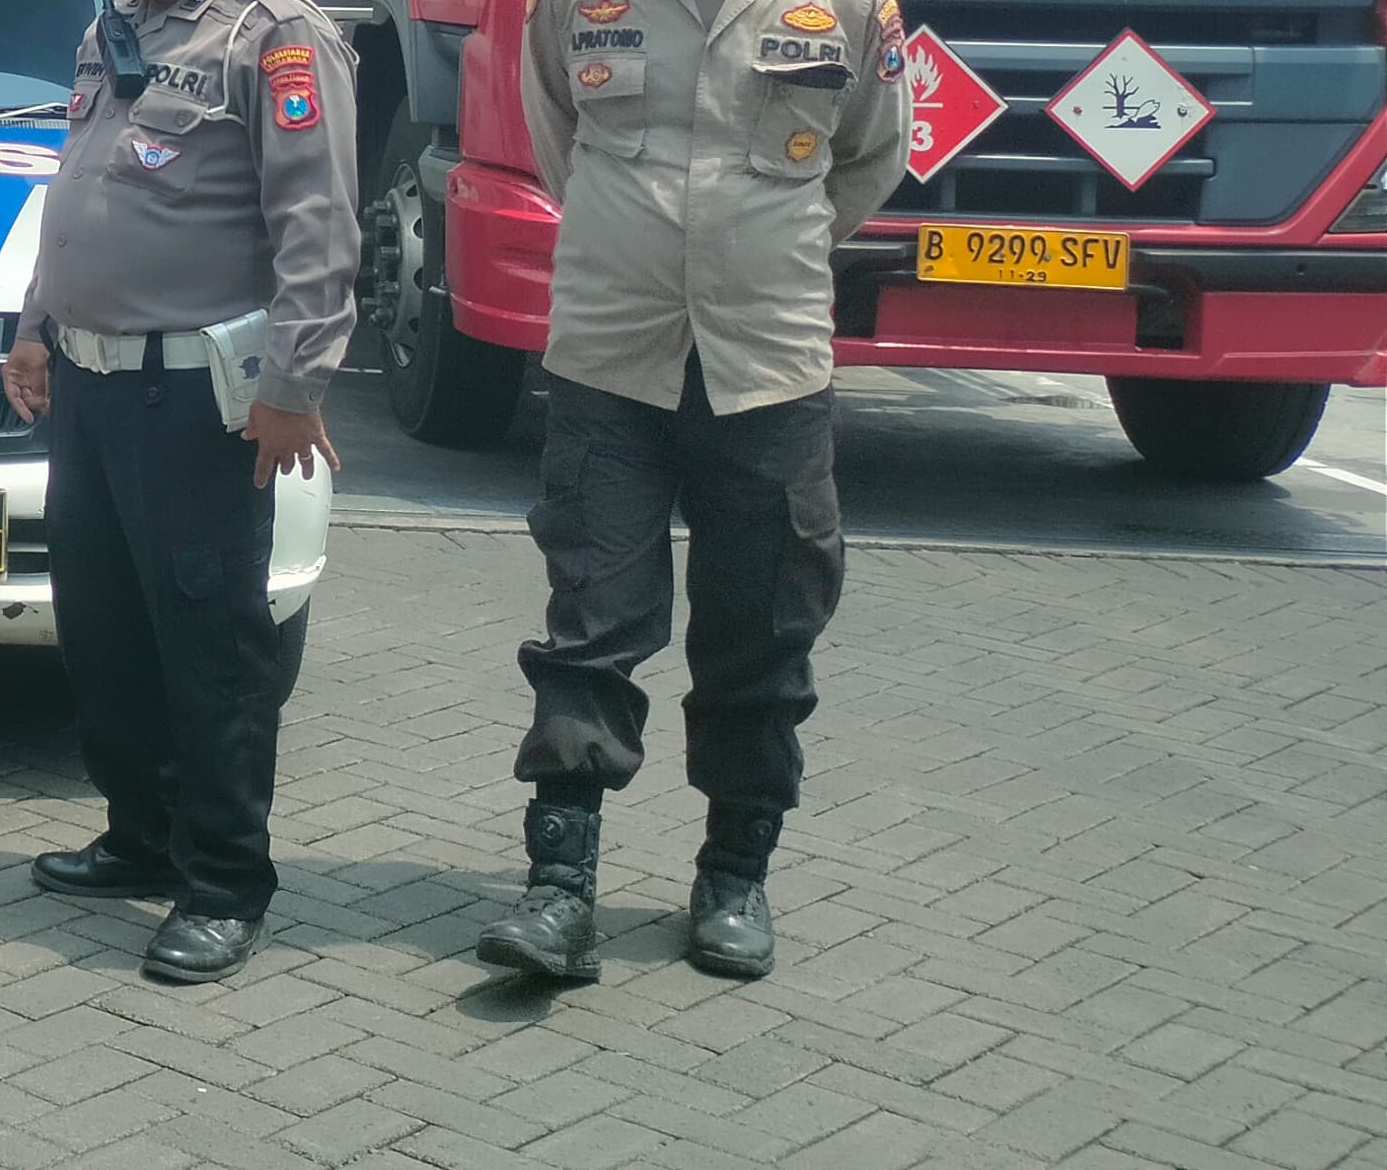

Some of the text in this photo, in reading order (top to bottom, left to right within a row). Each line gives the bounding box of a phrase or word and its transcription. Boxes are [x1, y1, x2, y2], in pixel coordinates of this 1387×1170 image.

[761, 37, 841, 63] POLRI
[147, 63, 208, 96] POLRI
[911, 120, 934, 152] 3
[924, 230, 1121, 270] B 9299 SFV
